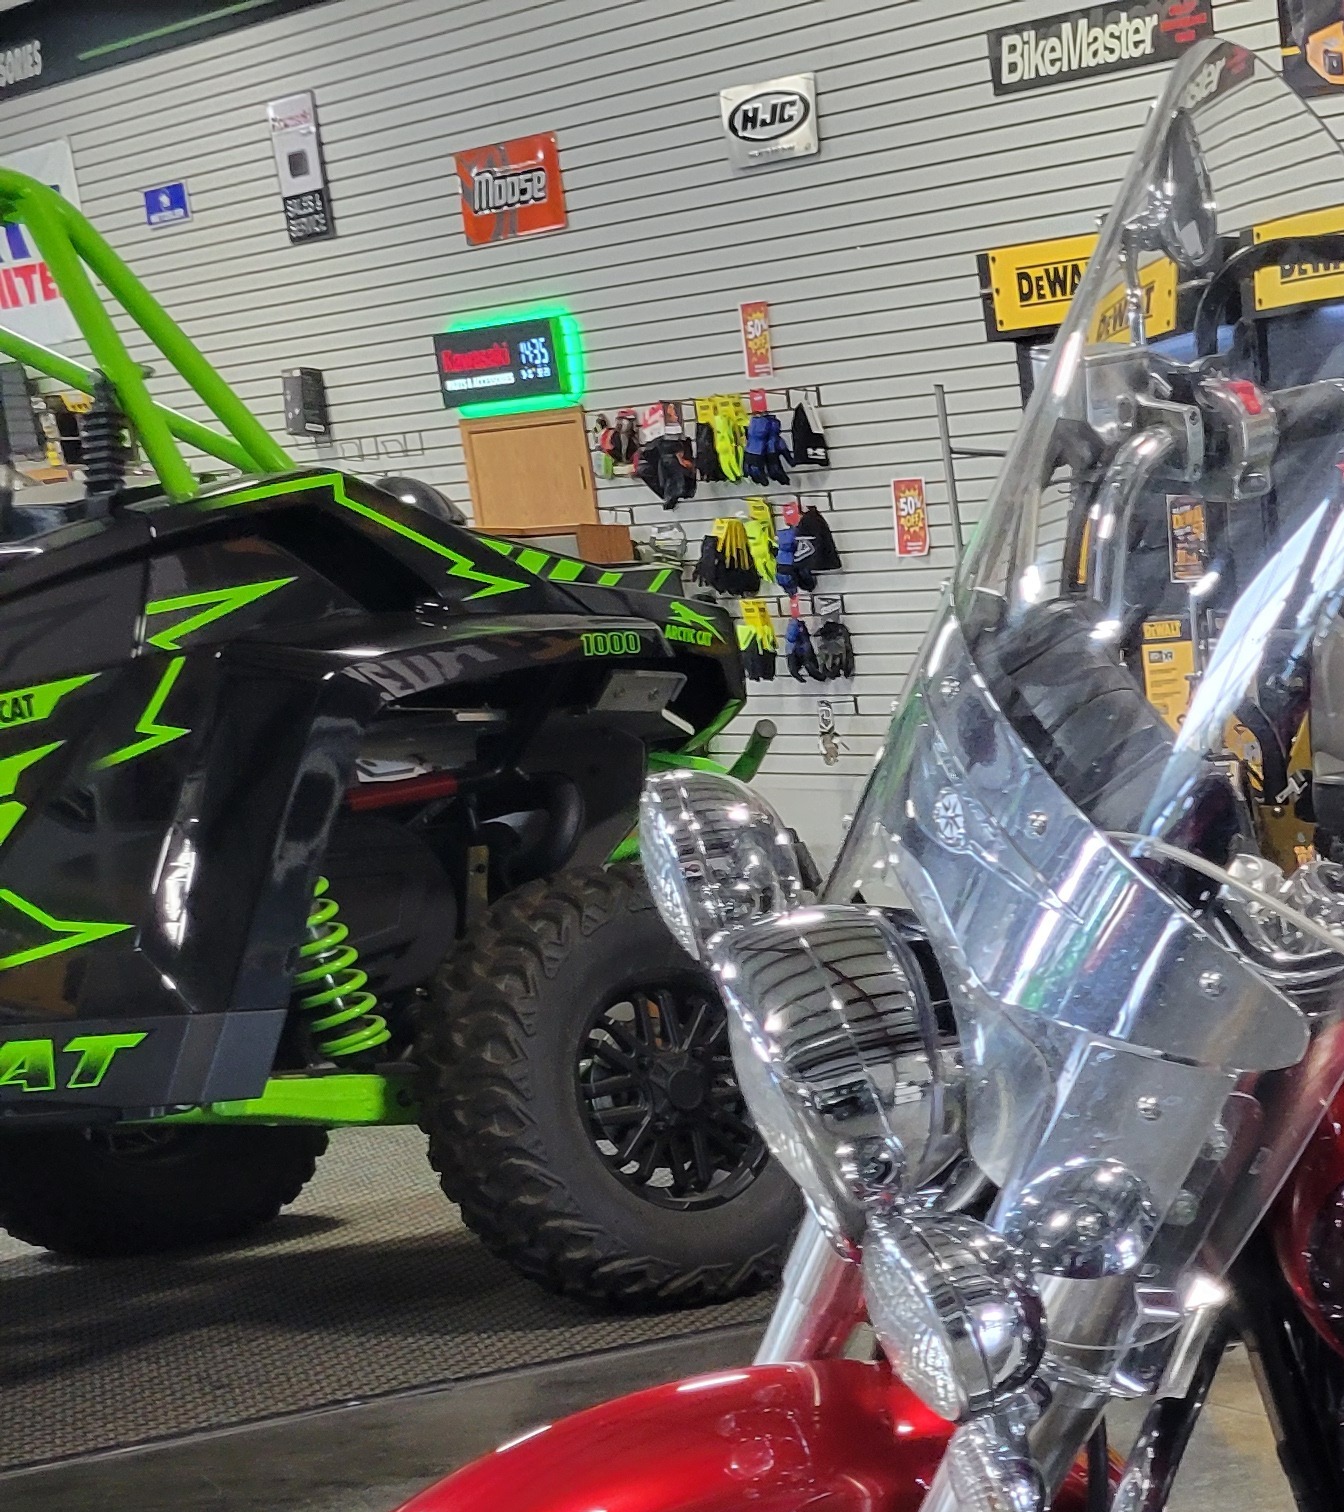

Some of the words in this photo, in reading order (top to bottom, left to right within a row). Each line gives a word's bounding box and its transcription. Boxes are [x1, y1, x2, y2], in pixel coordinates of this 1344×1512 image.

[1001, 12, 1158, 84] BikeMaster
[741, 100, 799, 132] HJC
[1017, 262, 1087, 303] DEWA
[581, 631, 641, 657] 1000
